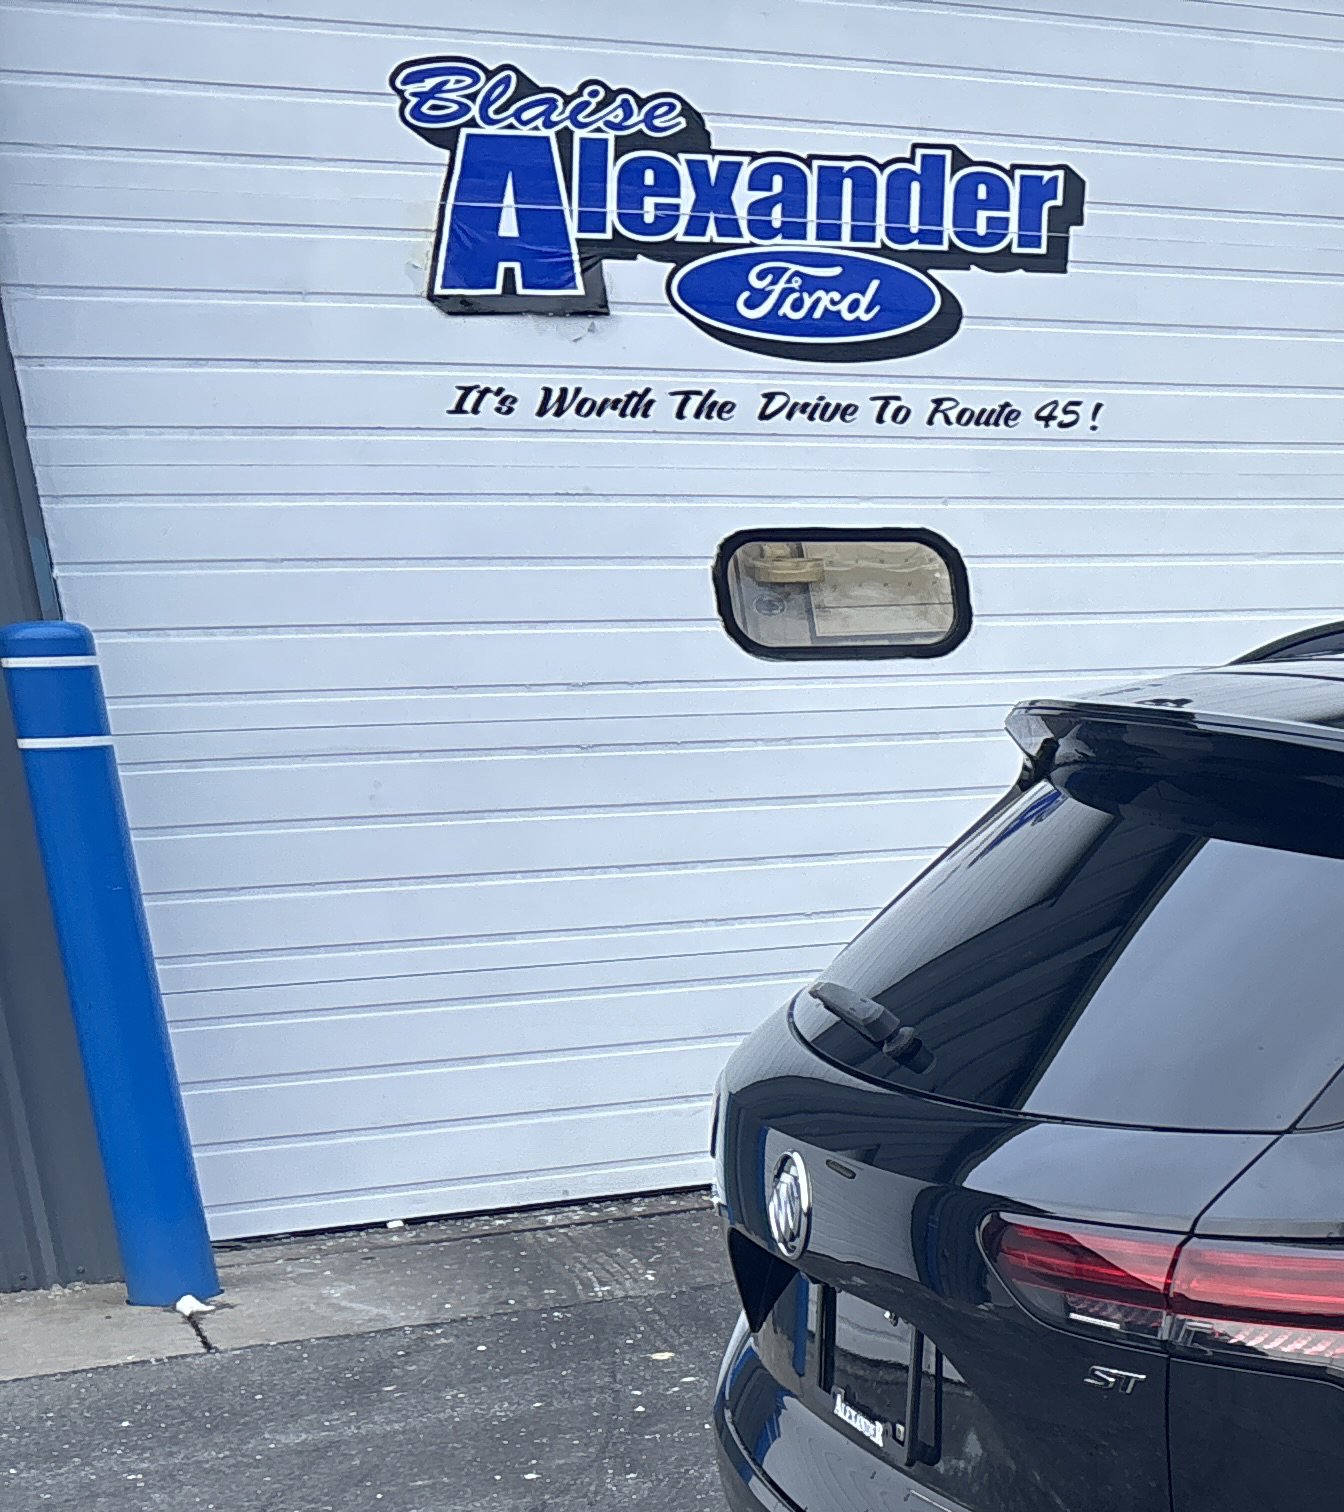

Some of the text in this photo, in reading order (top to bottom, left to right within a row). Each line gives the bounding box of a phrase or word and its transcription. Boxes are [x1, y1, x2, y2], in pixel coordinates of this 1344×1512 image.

[396, 62, 689, 138] Blaise
[433, 128, 1066, 296] Alexander
[737, 261, 881, 322] Ford
[446, 384, 518, 416] It's
[535, 386, 657, 418] Worth
[668, 389, 737, 421] The
[757, 391, 859, 424] Drive
[869, 395, 912, 425] To
[926, 397, 1023, 428] Route
[1083, 1364, 1147, 1394] ST
